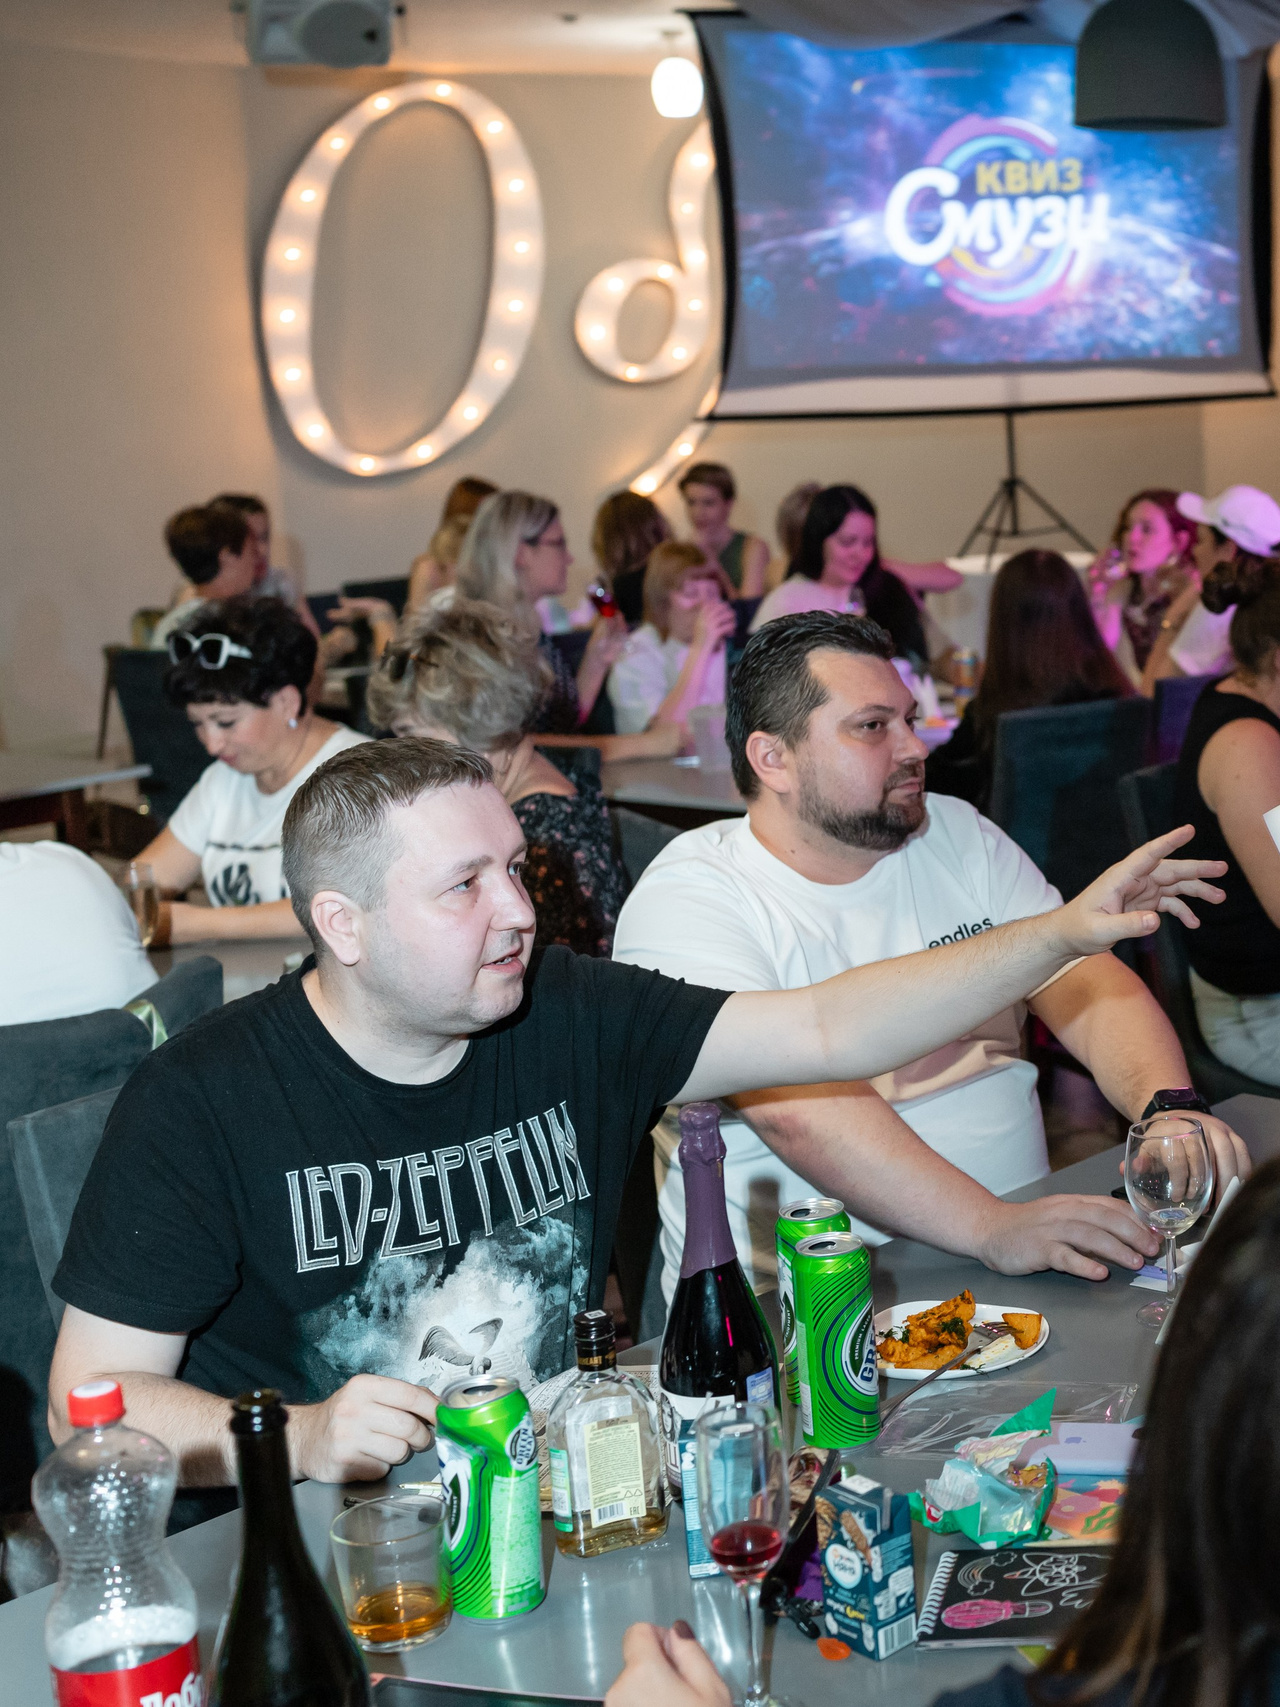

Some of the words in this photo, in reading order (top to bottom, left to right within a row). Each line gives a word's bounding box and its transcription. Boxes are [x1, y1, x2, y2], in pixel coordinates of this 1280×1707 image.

[976, 157, 1083, 196] КВИЗ
[885, 167, 1111, 269] Смузи
[854, 1333, 863, 1360] PREMIUM
[516, 1428, 529, 1465] GREEN
[139, 1671, 203, 1707] Доб
